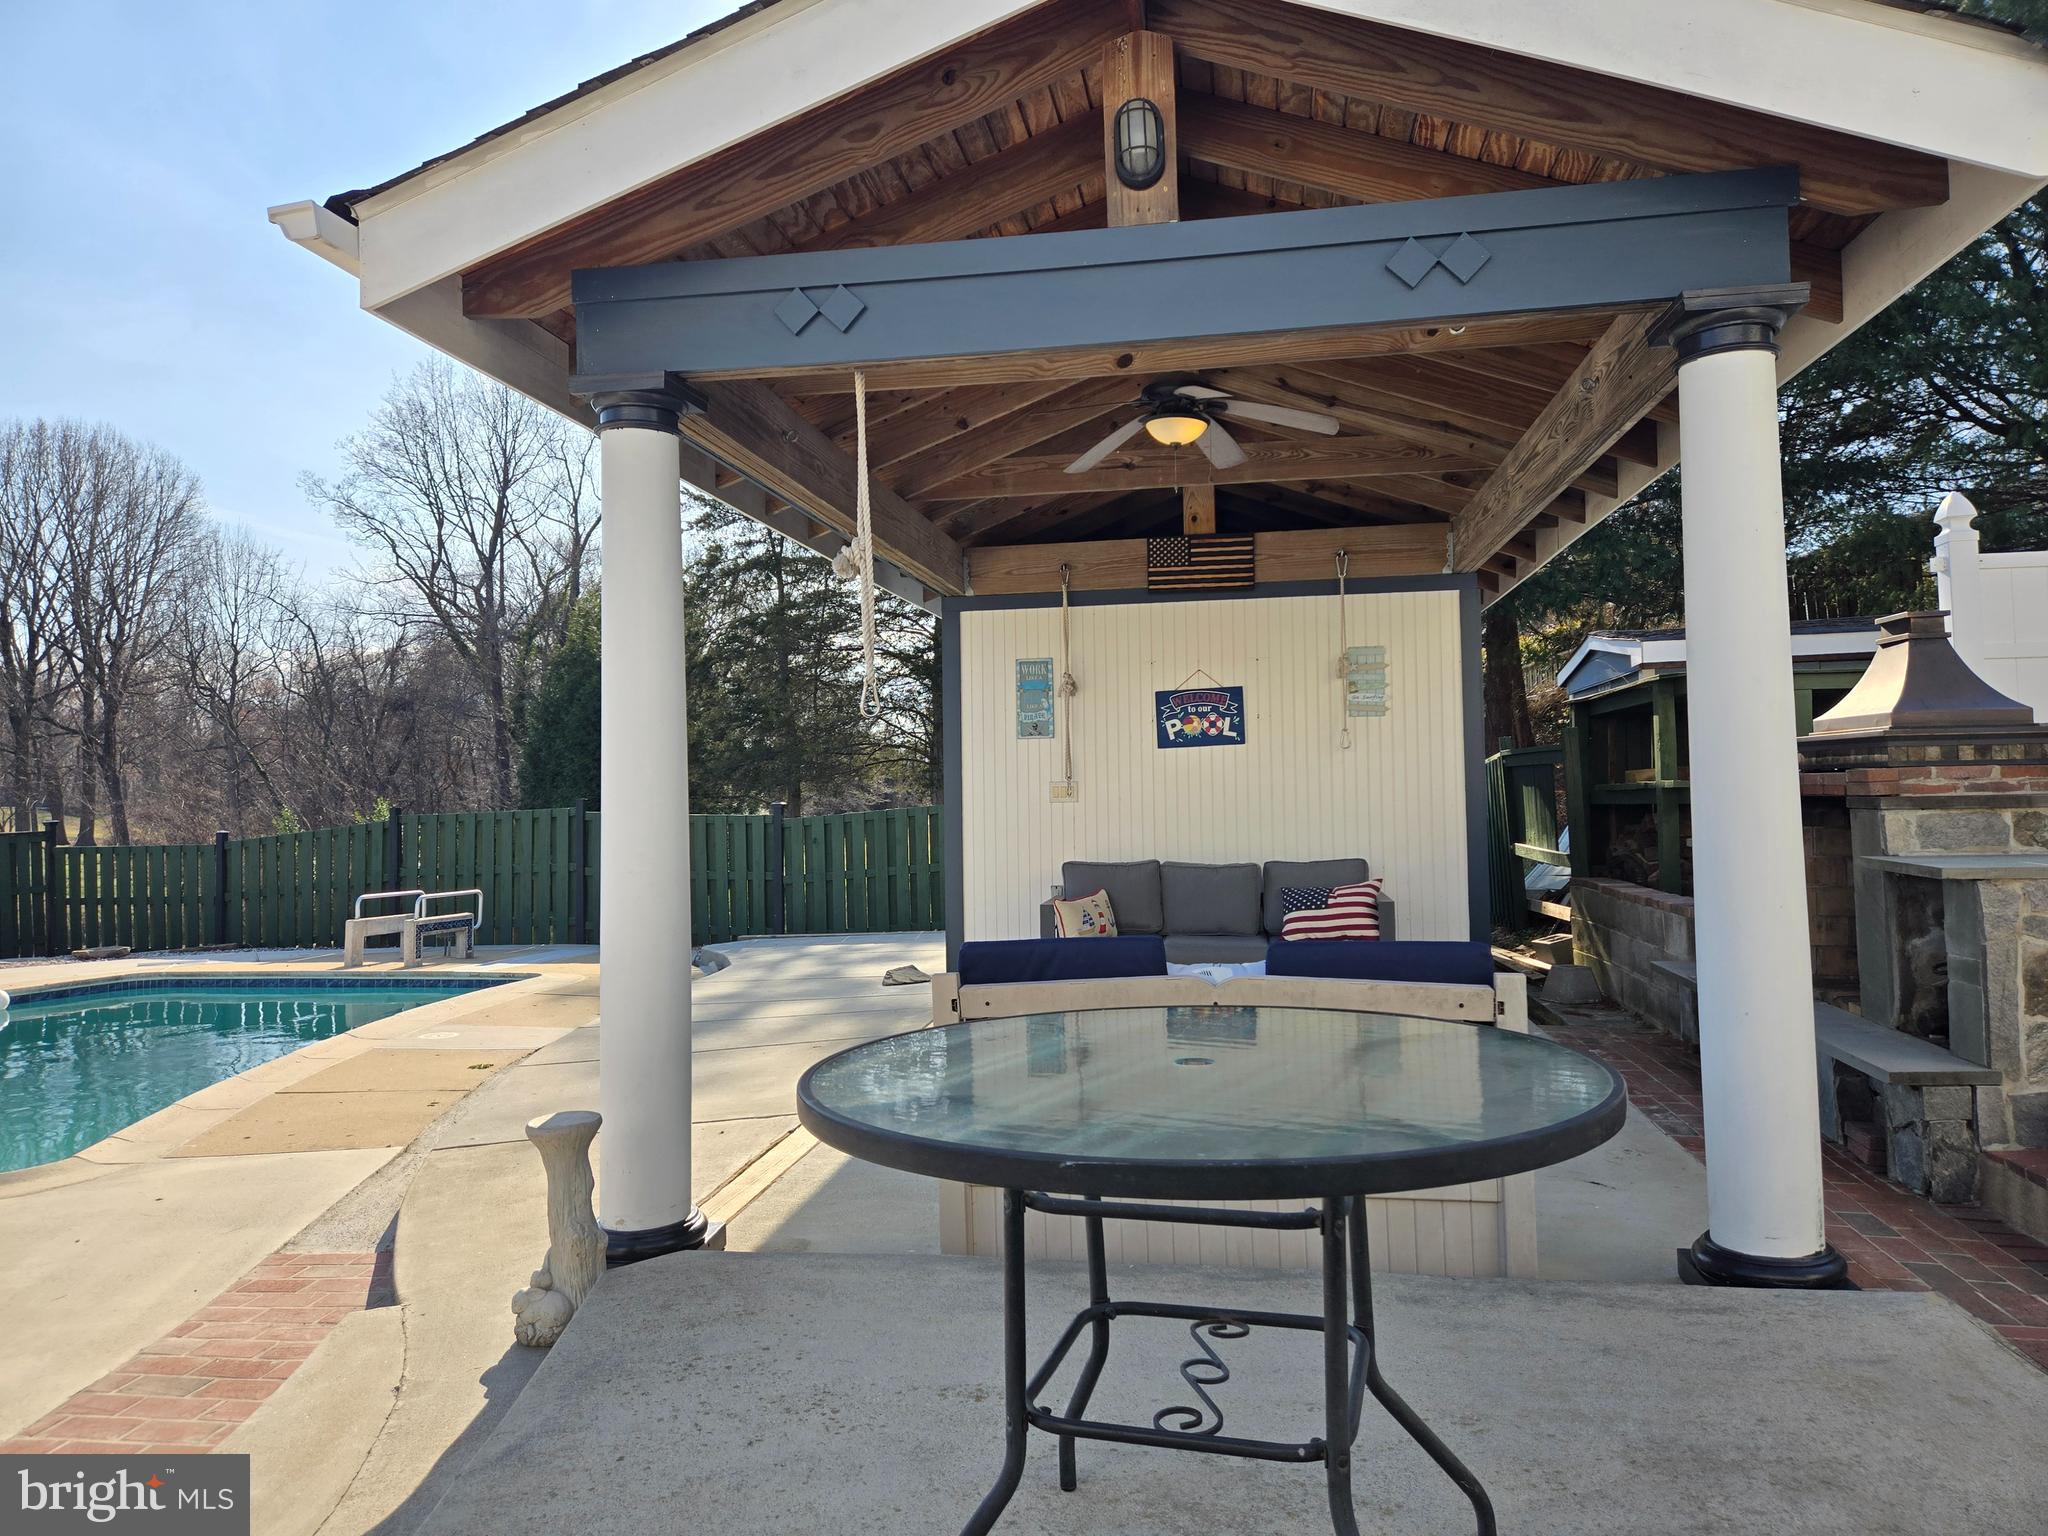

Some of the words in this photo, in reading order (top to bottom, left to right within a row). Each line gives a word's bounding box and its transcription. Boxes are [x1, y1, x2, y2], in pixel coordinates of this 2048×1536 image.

[1021, 663, 1047, 675] WORK
[1171, 692, 1228, 707] WELCOME
[1165, 712, 1237, 740] POOL
